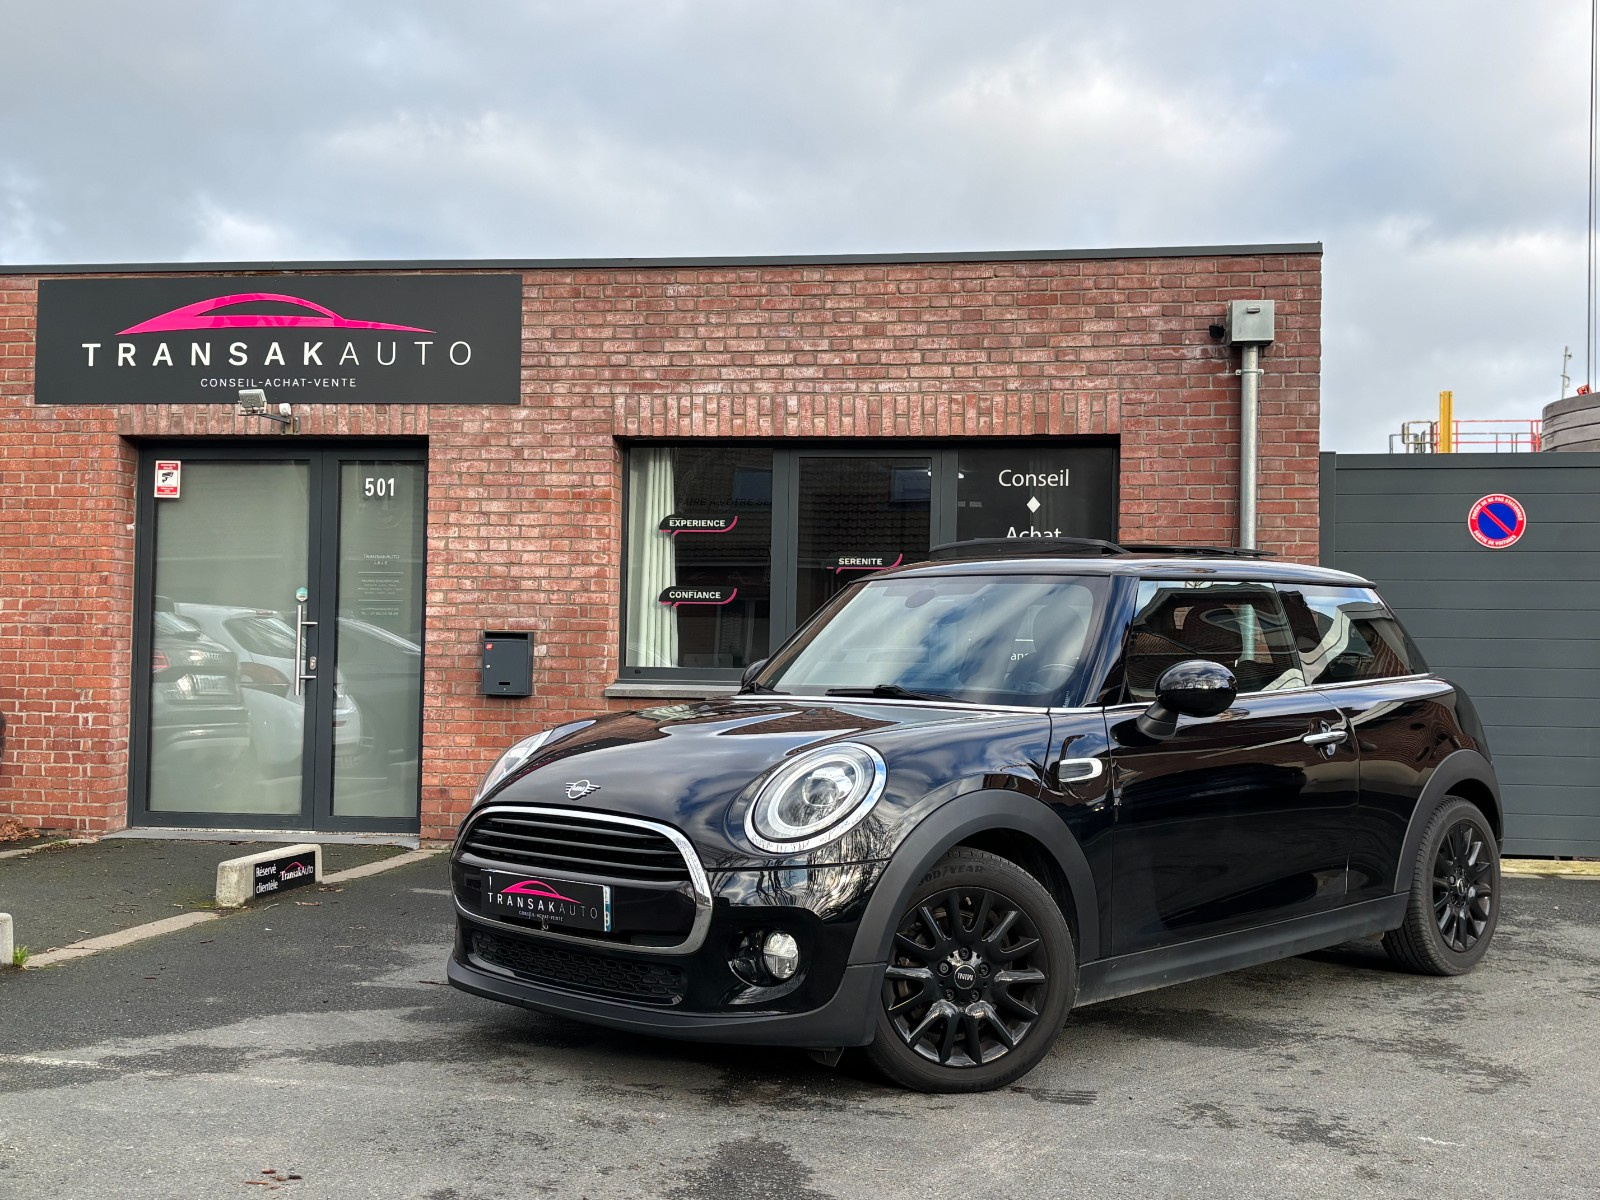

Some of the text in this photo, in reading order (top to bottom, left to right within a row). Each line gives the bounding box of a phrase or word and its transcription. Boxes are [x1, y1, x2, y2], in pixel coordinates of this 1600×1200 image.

[81, 341, 472, 367] TRANSAKAUTO
[200, 378, 357, 388] CONSEIL-ACHAT-VENTE
[998, 468, 1069, 487] Conseil
[364, 477, 395, 497] 501
[669, 519, 726, 527] EXPERIENCE
[1006, 525, 1062, 538] Achat
[838, 557, 883, 566] SERENITE
[669, 591, 722, 599] CONFIANCE
[255, 863, 277, 878] Réservé
[487, 892, 598, 920] TRANSAKAUTO
